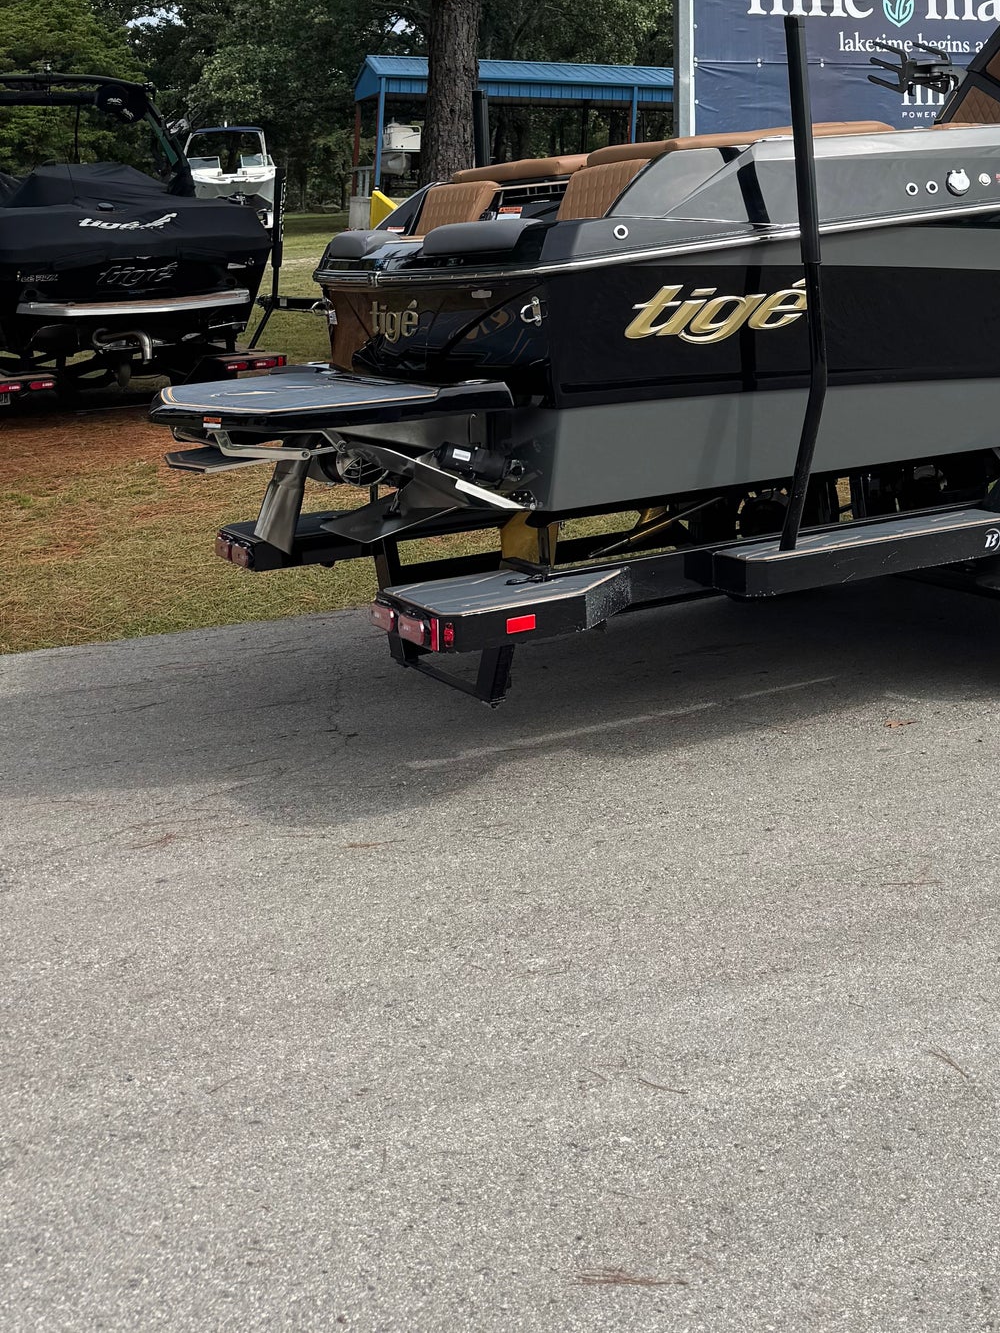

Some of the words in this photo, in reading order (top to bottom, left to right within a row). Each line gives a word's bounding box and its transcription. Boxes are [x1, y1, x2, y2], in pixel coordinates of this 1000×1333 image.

[838, 31, 914, 53] laketime
[918, 33, 970, 54] begins
[369, 298, 419, 344] tigé
[624, 278, 808, 345] tigé
